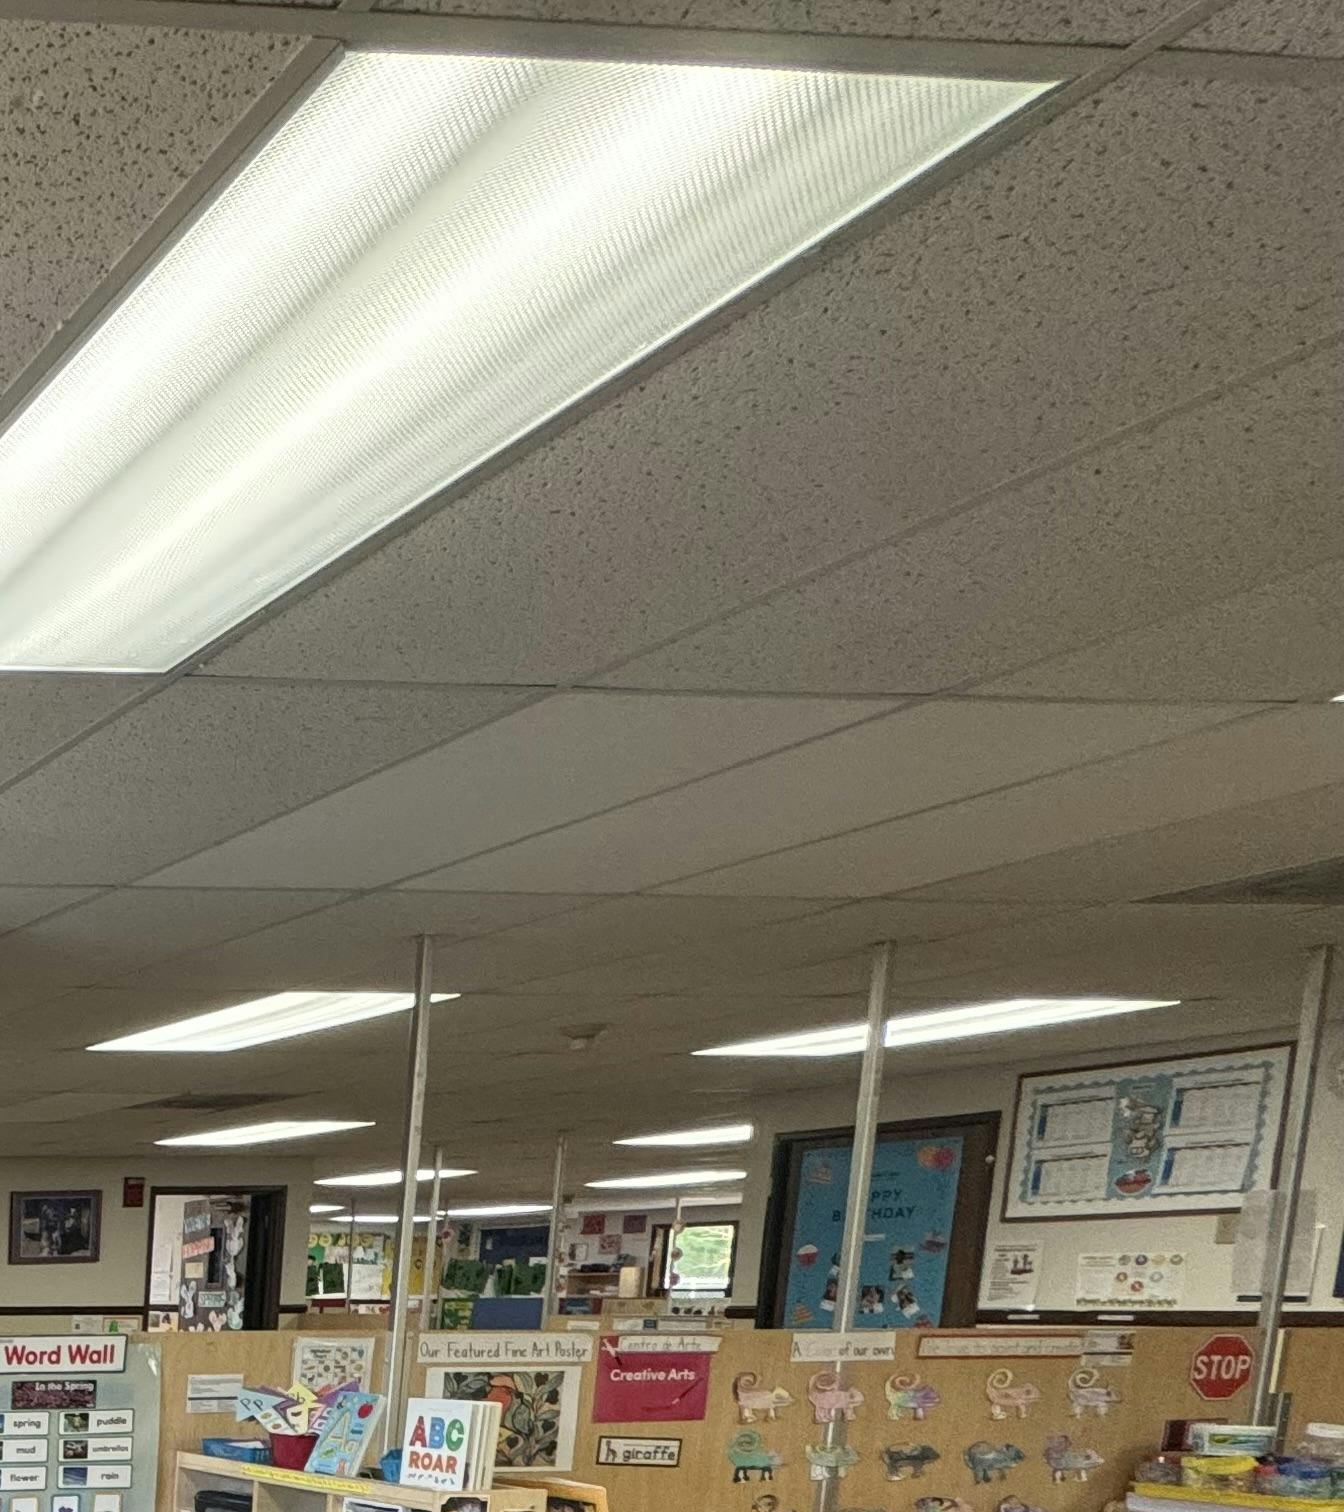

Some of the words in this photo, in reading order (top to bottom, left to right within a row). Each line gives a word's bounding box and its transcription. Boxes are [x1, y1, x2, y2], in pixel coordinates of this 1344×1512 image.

[4, 1345, 62, 1365] Word
[68, 1344, 115, 1364] Wall
[420, 1342, 439, 1358] Our
[447, 1342, 500, 1358] Featured
[505, 1342, 527, 1357] Fine
[532, 1342, 550, 1358] Art
[555, 1342, 588, 1361] Poster
[853, 1347, 869, 1356] our
[1193, 1355, 1251, 1381] STOP
[610, 1368, 665, 1381] Creative
[667, 1368, 696, 1381] Arts
[48, 1382, 63, 1391] the
[64, 1381, 94, 1392] Spring
[13, 1419, 41, 1429] spring
[96, 1416, 127, 1426] puddle
[409, 1415, 464, 1451] ABC
[16, 1446, 36, 1454] mud
[623, 1445, 675, 1462] giraffe
[409, 1452, 458, 1474] ROAR
[10, 1474, 39, 1483] flower
[101, 1472, 119, 1480] rain
